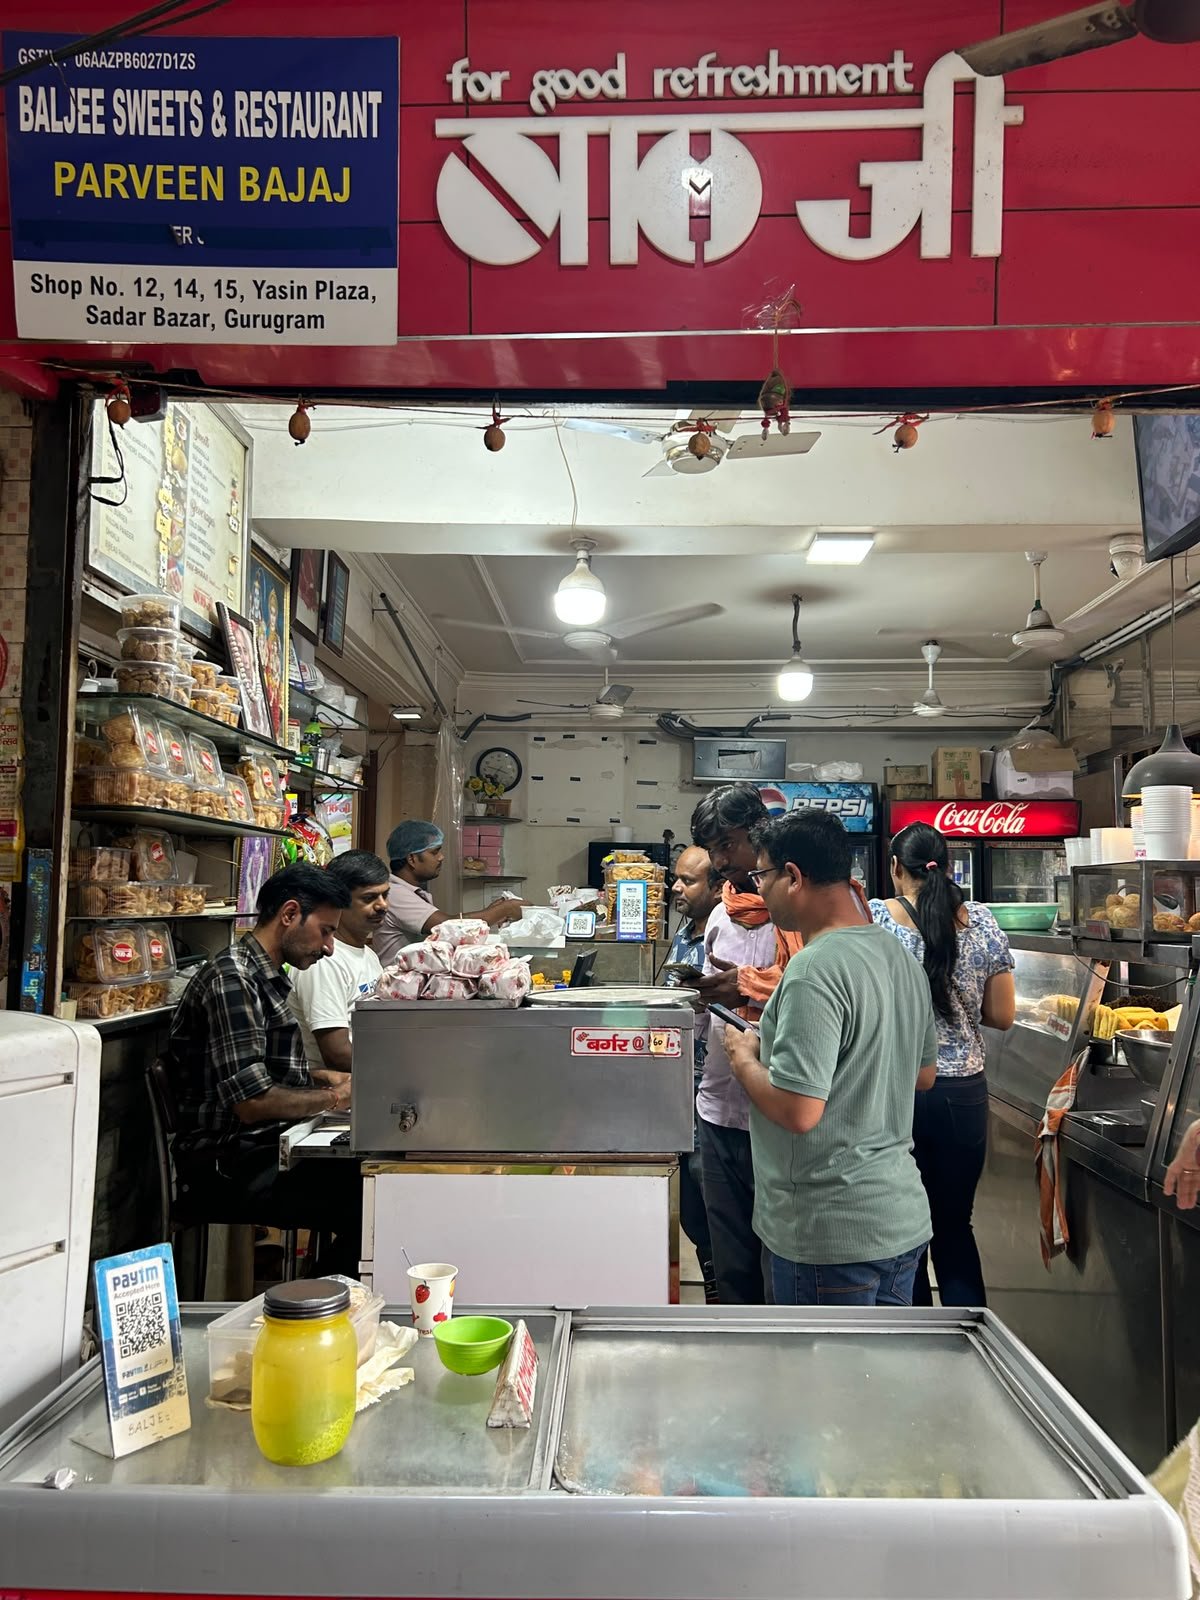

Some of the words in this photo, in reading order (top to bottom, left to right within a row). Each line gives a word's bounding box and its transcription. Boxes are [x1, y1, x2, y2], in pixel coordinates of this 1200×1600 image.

[446, 57, 510, 102] for
[530, 52, 626, 115] good
[654, 50, 914, 99] refreshment
[19, 85, 105, 135] BALJEE
[112, 88, 203, 138] SWEETS
[210, 90, 228, 138] &
[235, 90, 382, 138] RESTAURANT
[54, 161, 224, 201] PARVEEN
[239, 166, 351, 203] BAJAJ
[30, 273, 82, 296] Shop
[90, 275, 124, 297] No.
[133, 277, 164, 300] 12,
[174, 278, 204, 301] 14,
[214, 279, 245, 302] 15,
[252, 279, 308, 300] Yasin
[315, 280, 376, 303] Plaza,
[86, 304, 146, 326] Sadar
[153, 306, 215, 330] Bazar,
[224, 308, 325, 332] Gurugram
[933, 802, 1030, 834] Coca-Cola
[586, 1034, 630, 1052] बर्गर
